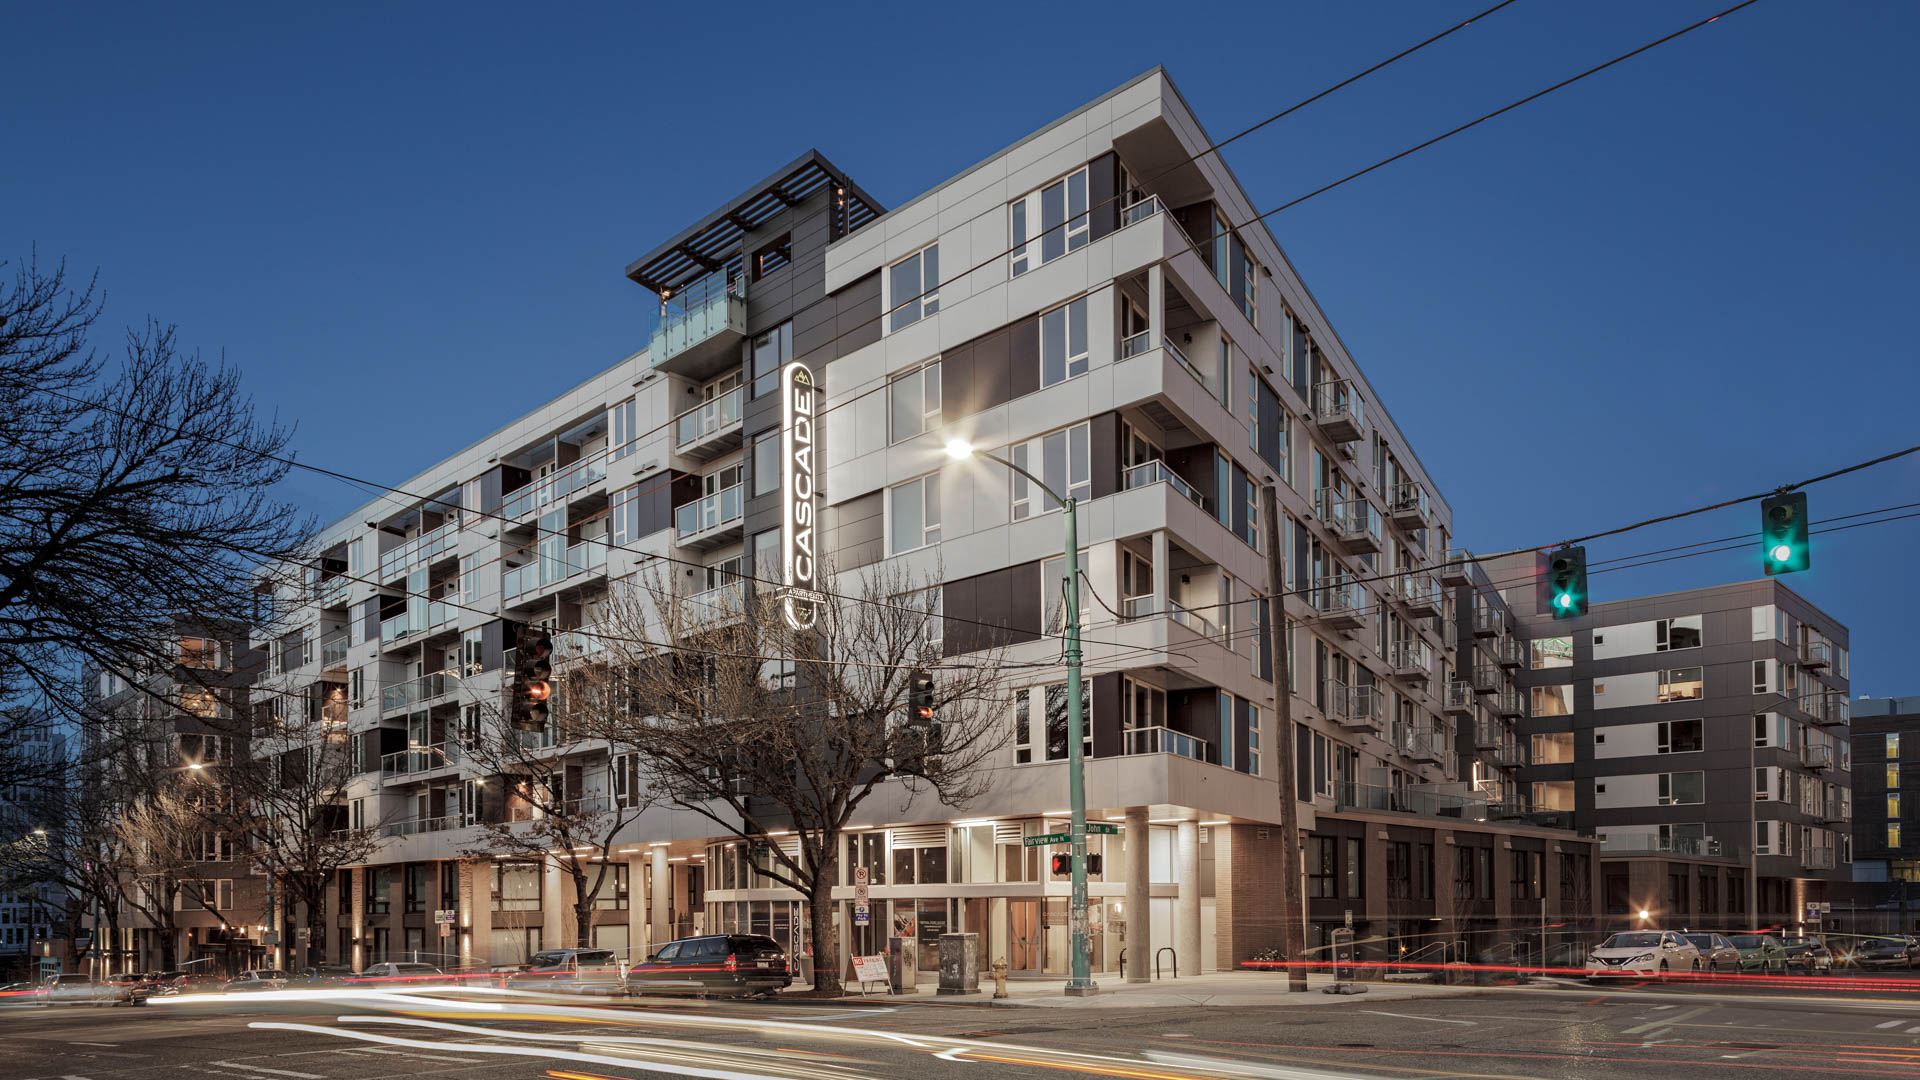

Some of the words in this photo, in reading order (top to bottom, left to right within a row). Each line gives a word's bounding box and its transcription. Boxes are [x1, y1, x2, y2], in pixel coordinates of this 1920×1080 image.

[795, 387, 812, 581] CASCADE
[788, 588, 824, 601] APARTMENTS
[1087, 824, 1101, 833] John
[1024, 837, 1048, 846] Fairview
